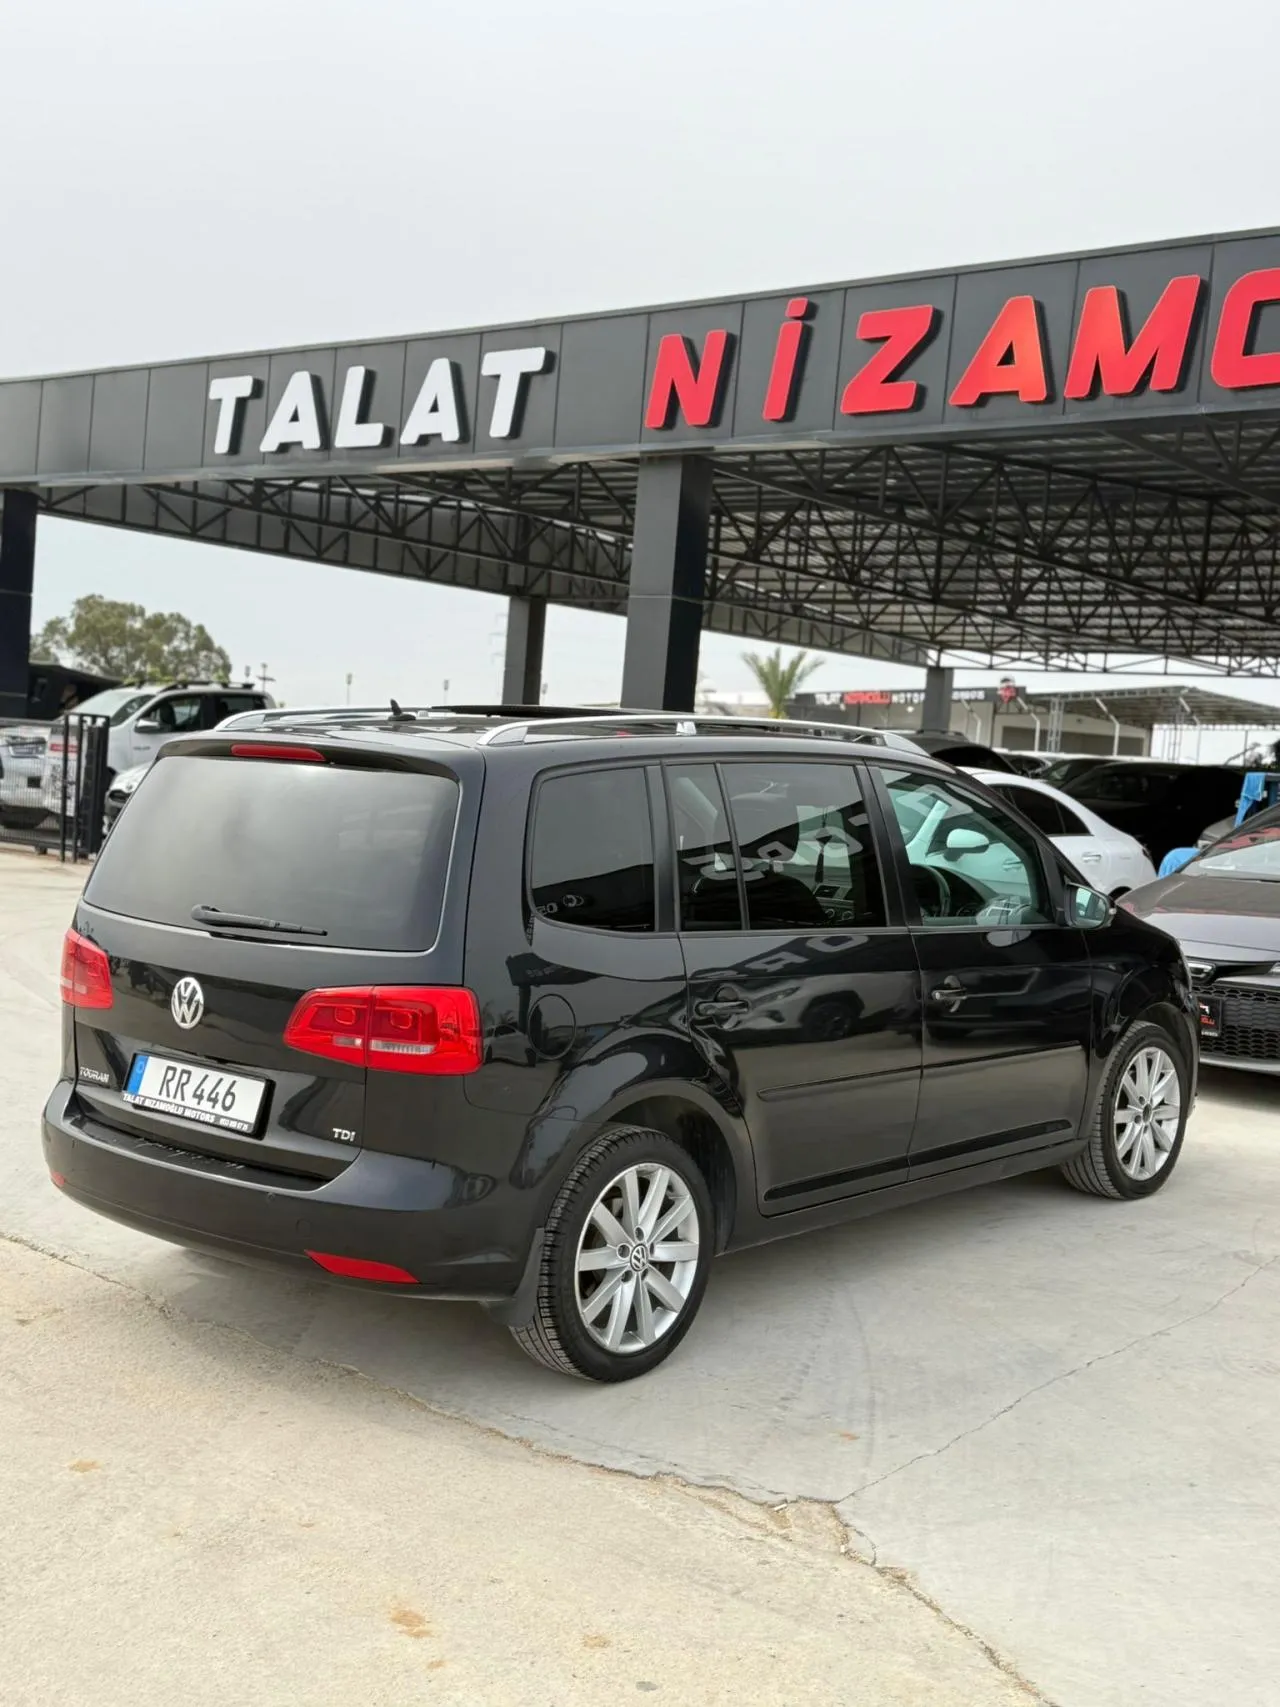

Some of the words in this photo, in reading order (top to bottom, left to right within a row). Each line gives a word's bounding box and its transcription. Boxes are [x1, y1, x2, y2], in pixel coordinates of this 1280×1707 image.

[208, 346, 547, 455] TALAT
[158, 1065, 192, 1101] RR
[192, 1074, 237, 1112] 446
[184, 1108, 216, 1123] MOTORS
[332, 1127, 356, 1142] TDI
